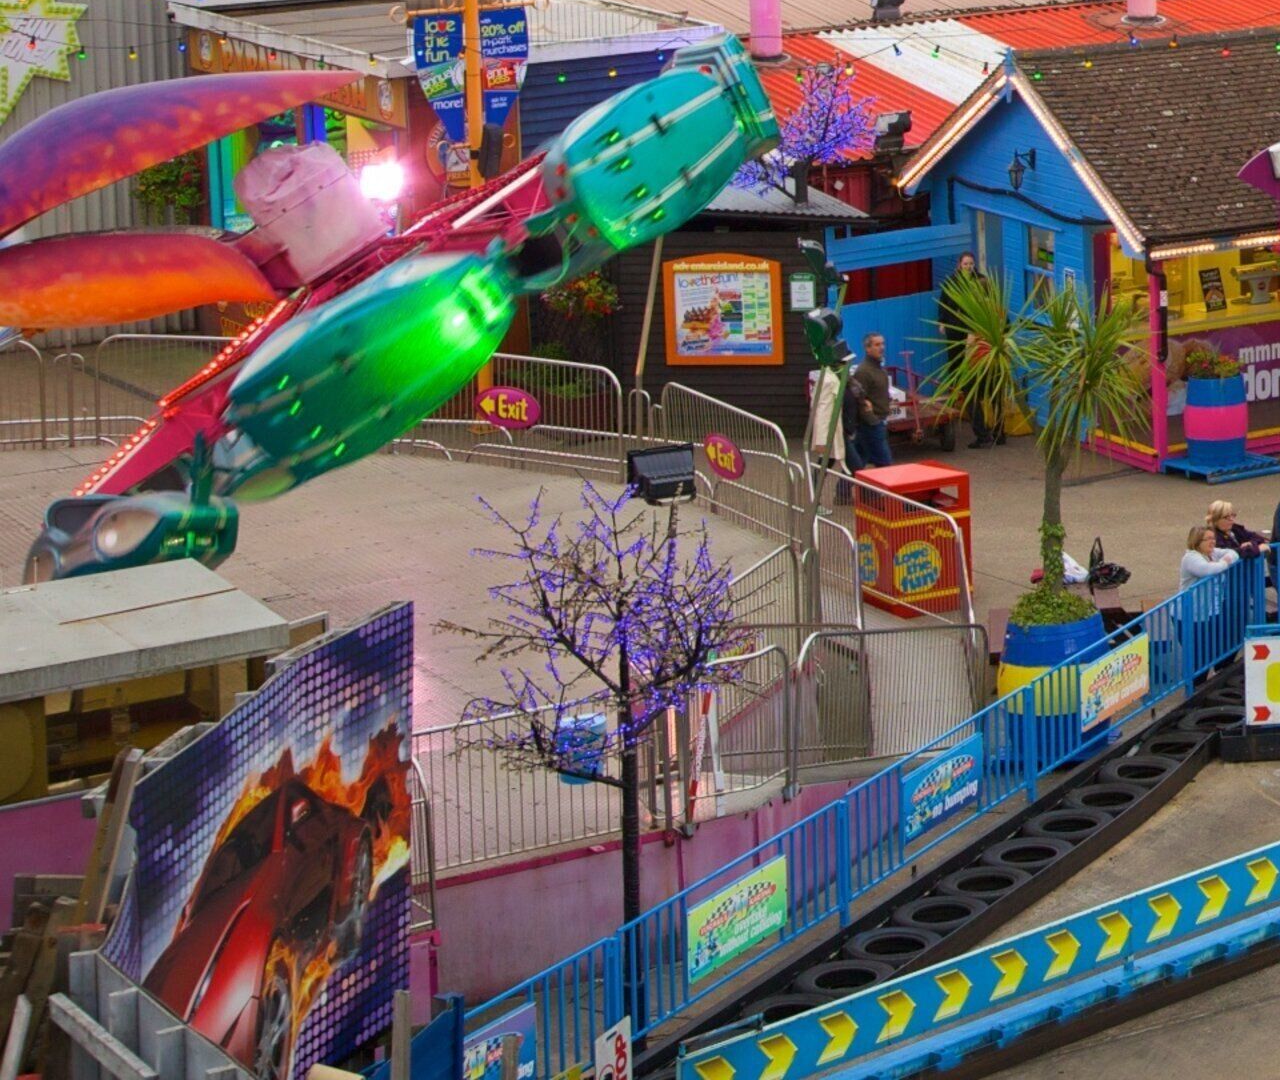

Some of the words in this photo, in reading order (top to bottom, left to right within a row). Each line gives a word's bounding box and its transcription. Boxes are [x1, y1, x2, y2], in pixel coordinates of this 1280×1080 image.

[482, 24, 506, 37] 20%
[507, 21, 525, 34] off
[433, 97, 464, 110] more!
[673, 261, 770, 272] adventureisland.co.uk
[498, 394, 529, 421] Exit
[716, 442, 737, 474] Exit
[894, 546, 931, 567] Love
[906, 559, 934, 574] the
[944, 779, 979, 811] bumping
